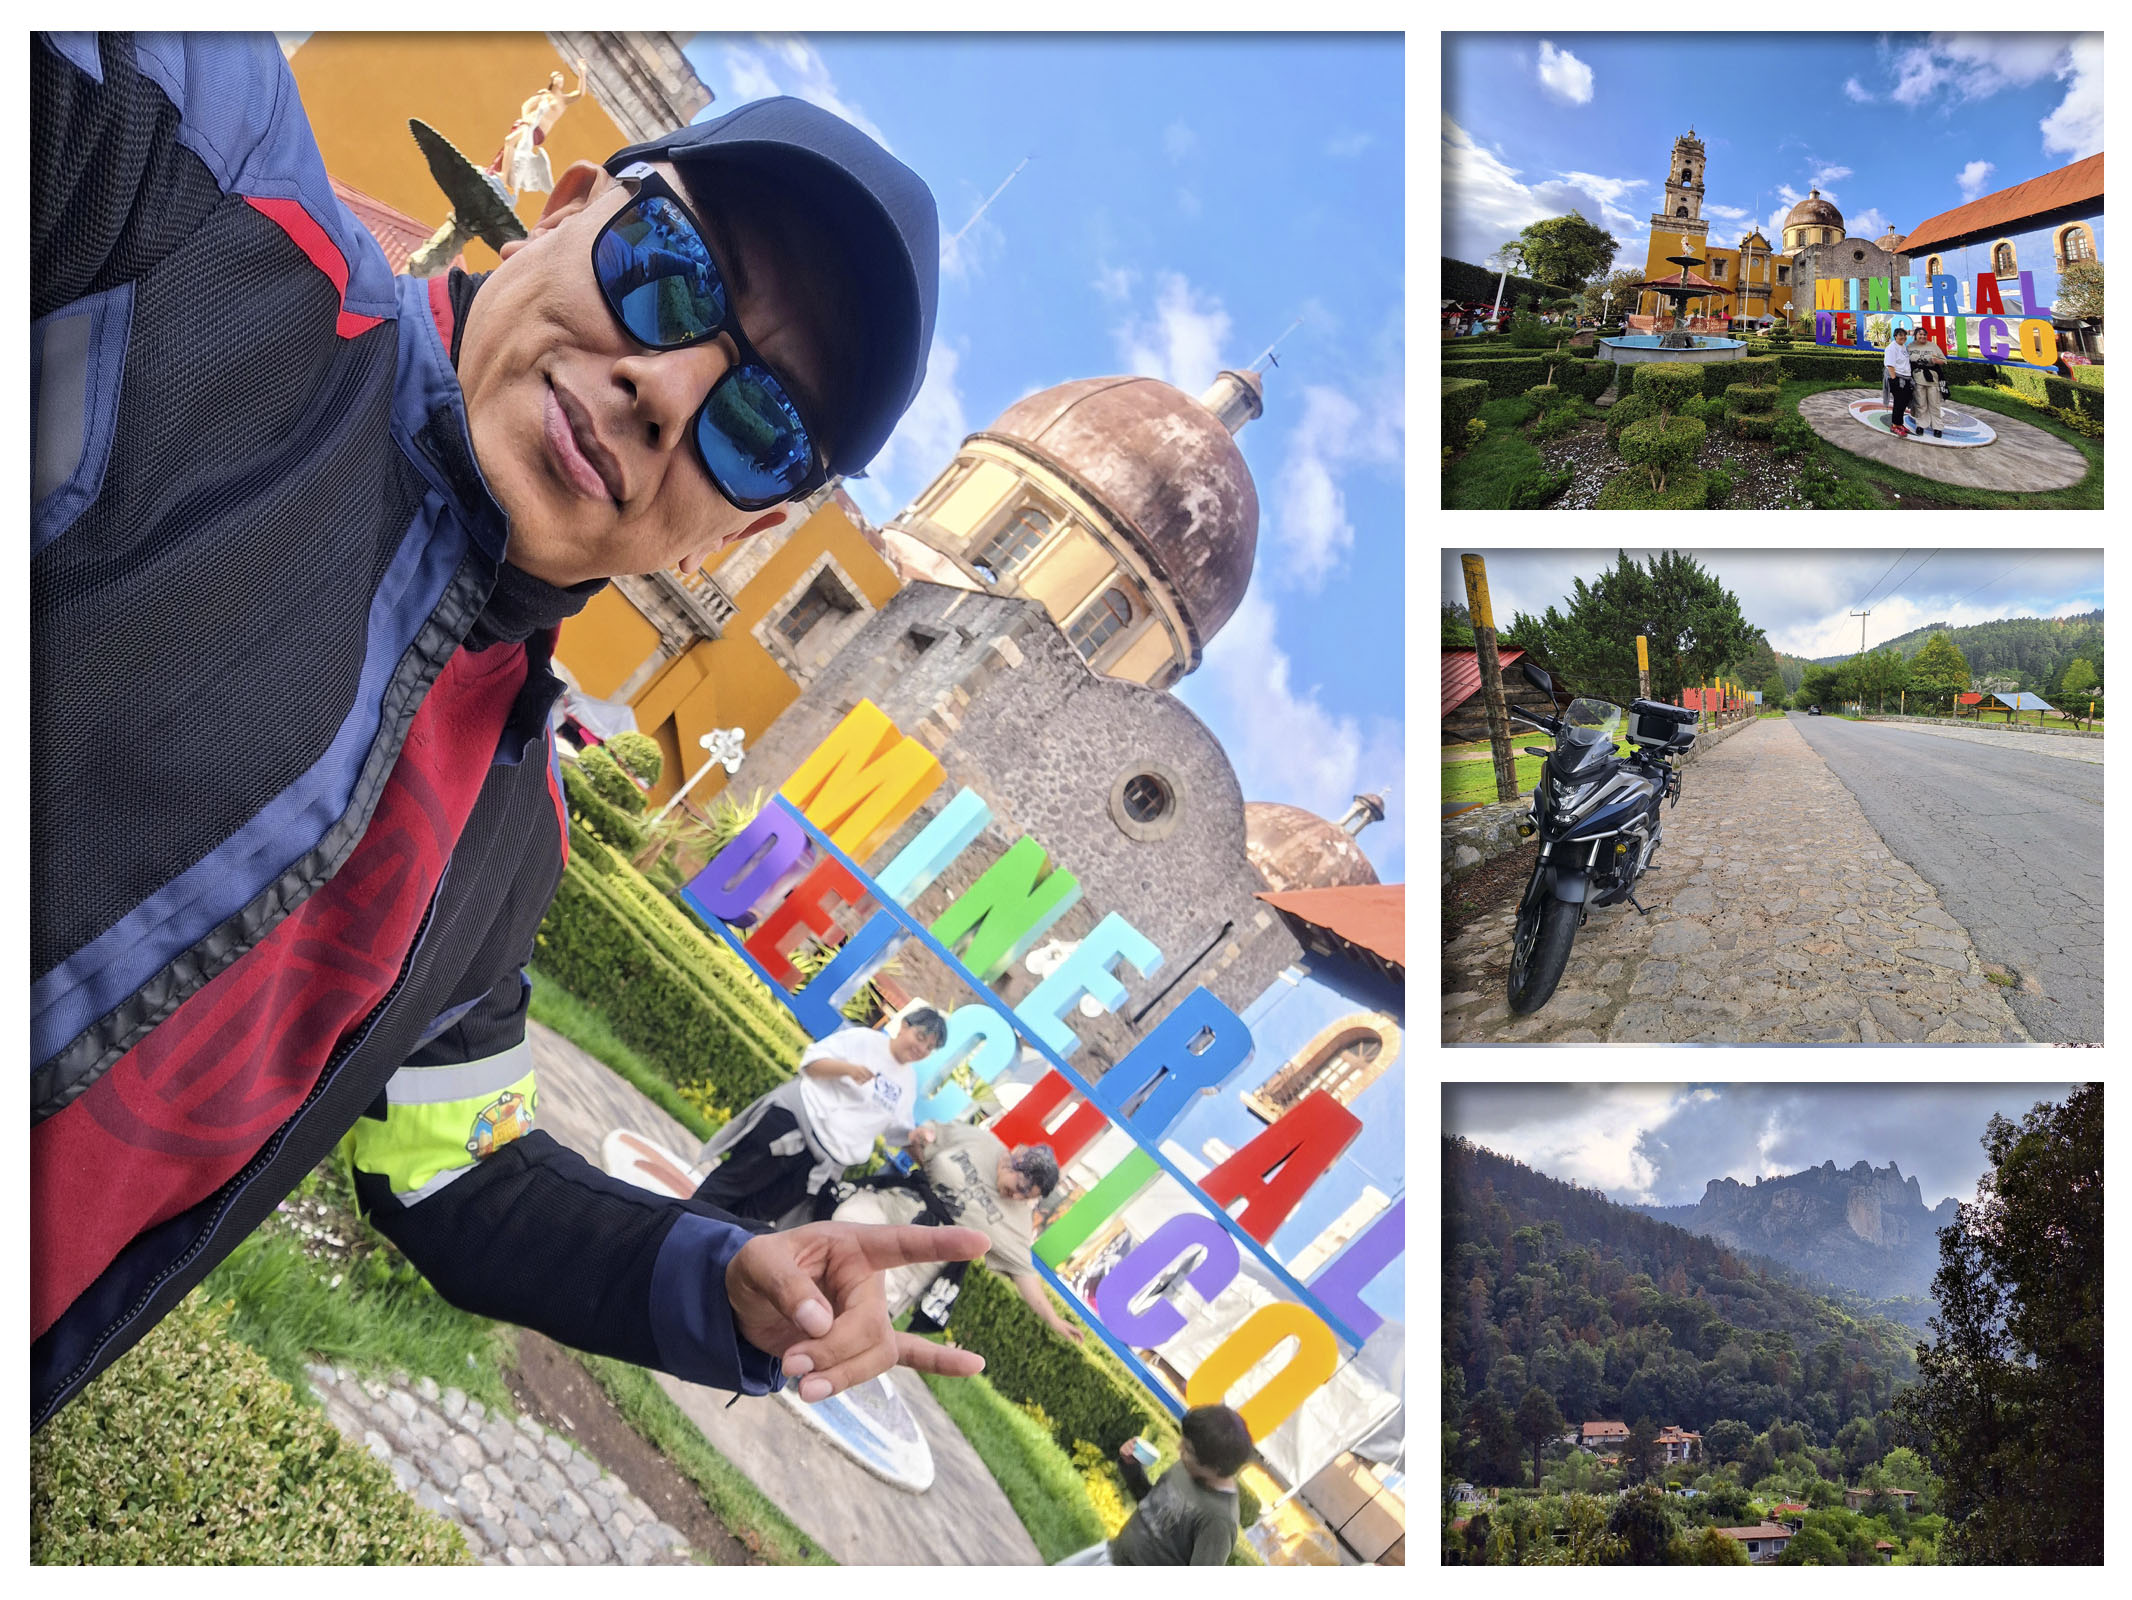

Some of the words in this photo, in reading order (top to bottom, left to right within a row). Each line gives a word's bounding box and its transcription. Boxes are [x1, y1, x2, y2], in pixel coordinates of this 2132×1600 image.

[1815, 271, 2051, 315] MINERAL
[1816, 312, 1873, 351] DEL
[689, 799, 913, 1040] DEL
[913, 1003, 1339, 1444] CHICO
[779, 698, 1404, 1341] MINERAL
